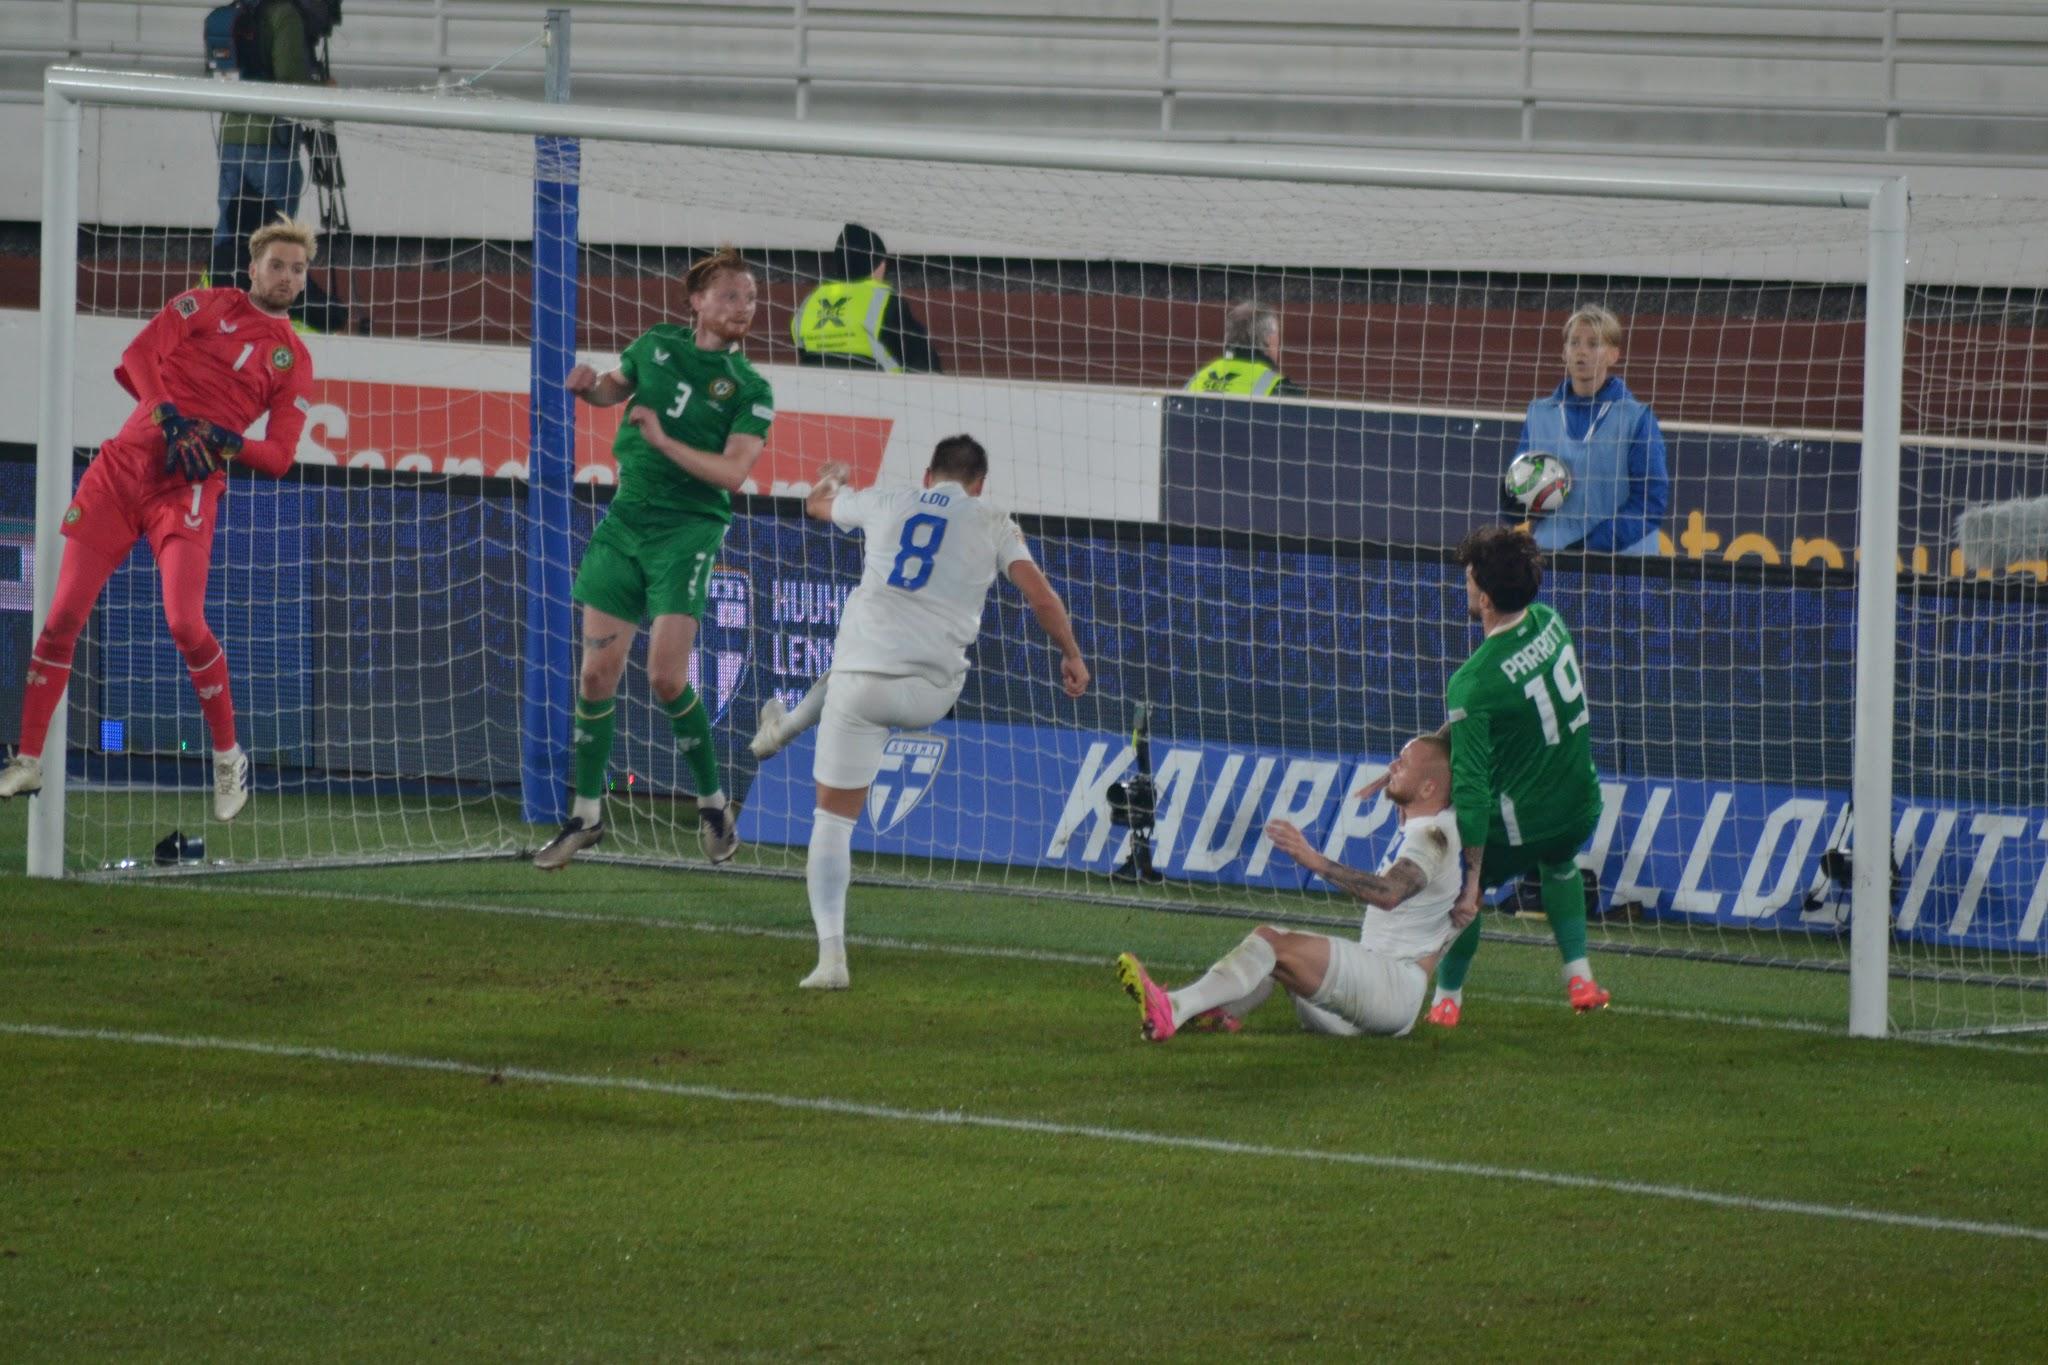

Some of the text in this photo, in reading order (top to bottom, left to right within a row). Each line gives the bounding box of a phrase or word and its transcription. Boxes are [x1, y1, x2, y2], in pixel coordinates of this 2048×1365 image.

[231, 343, 254, 372] 1
[666, 381, 692, 418] 3
[191, 484, 203, 516] 1
[920, 492, 951, 508] LOD
[886, 513, 948, 592] 8
[772, 580, 855, 626] HUUH
[1523, 643, 1589, 746] 19
[892, 743, 936, 753] SUOMI
[1046, 743, 1404, 880] KAUPP
